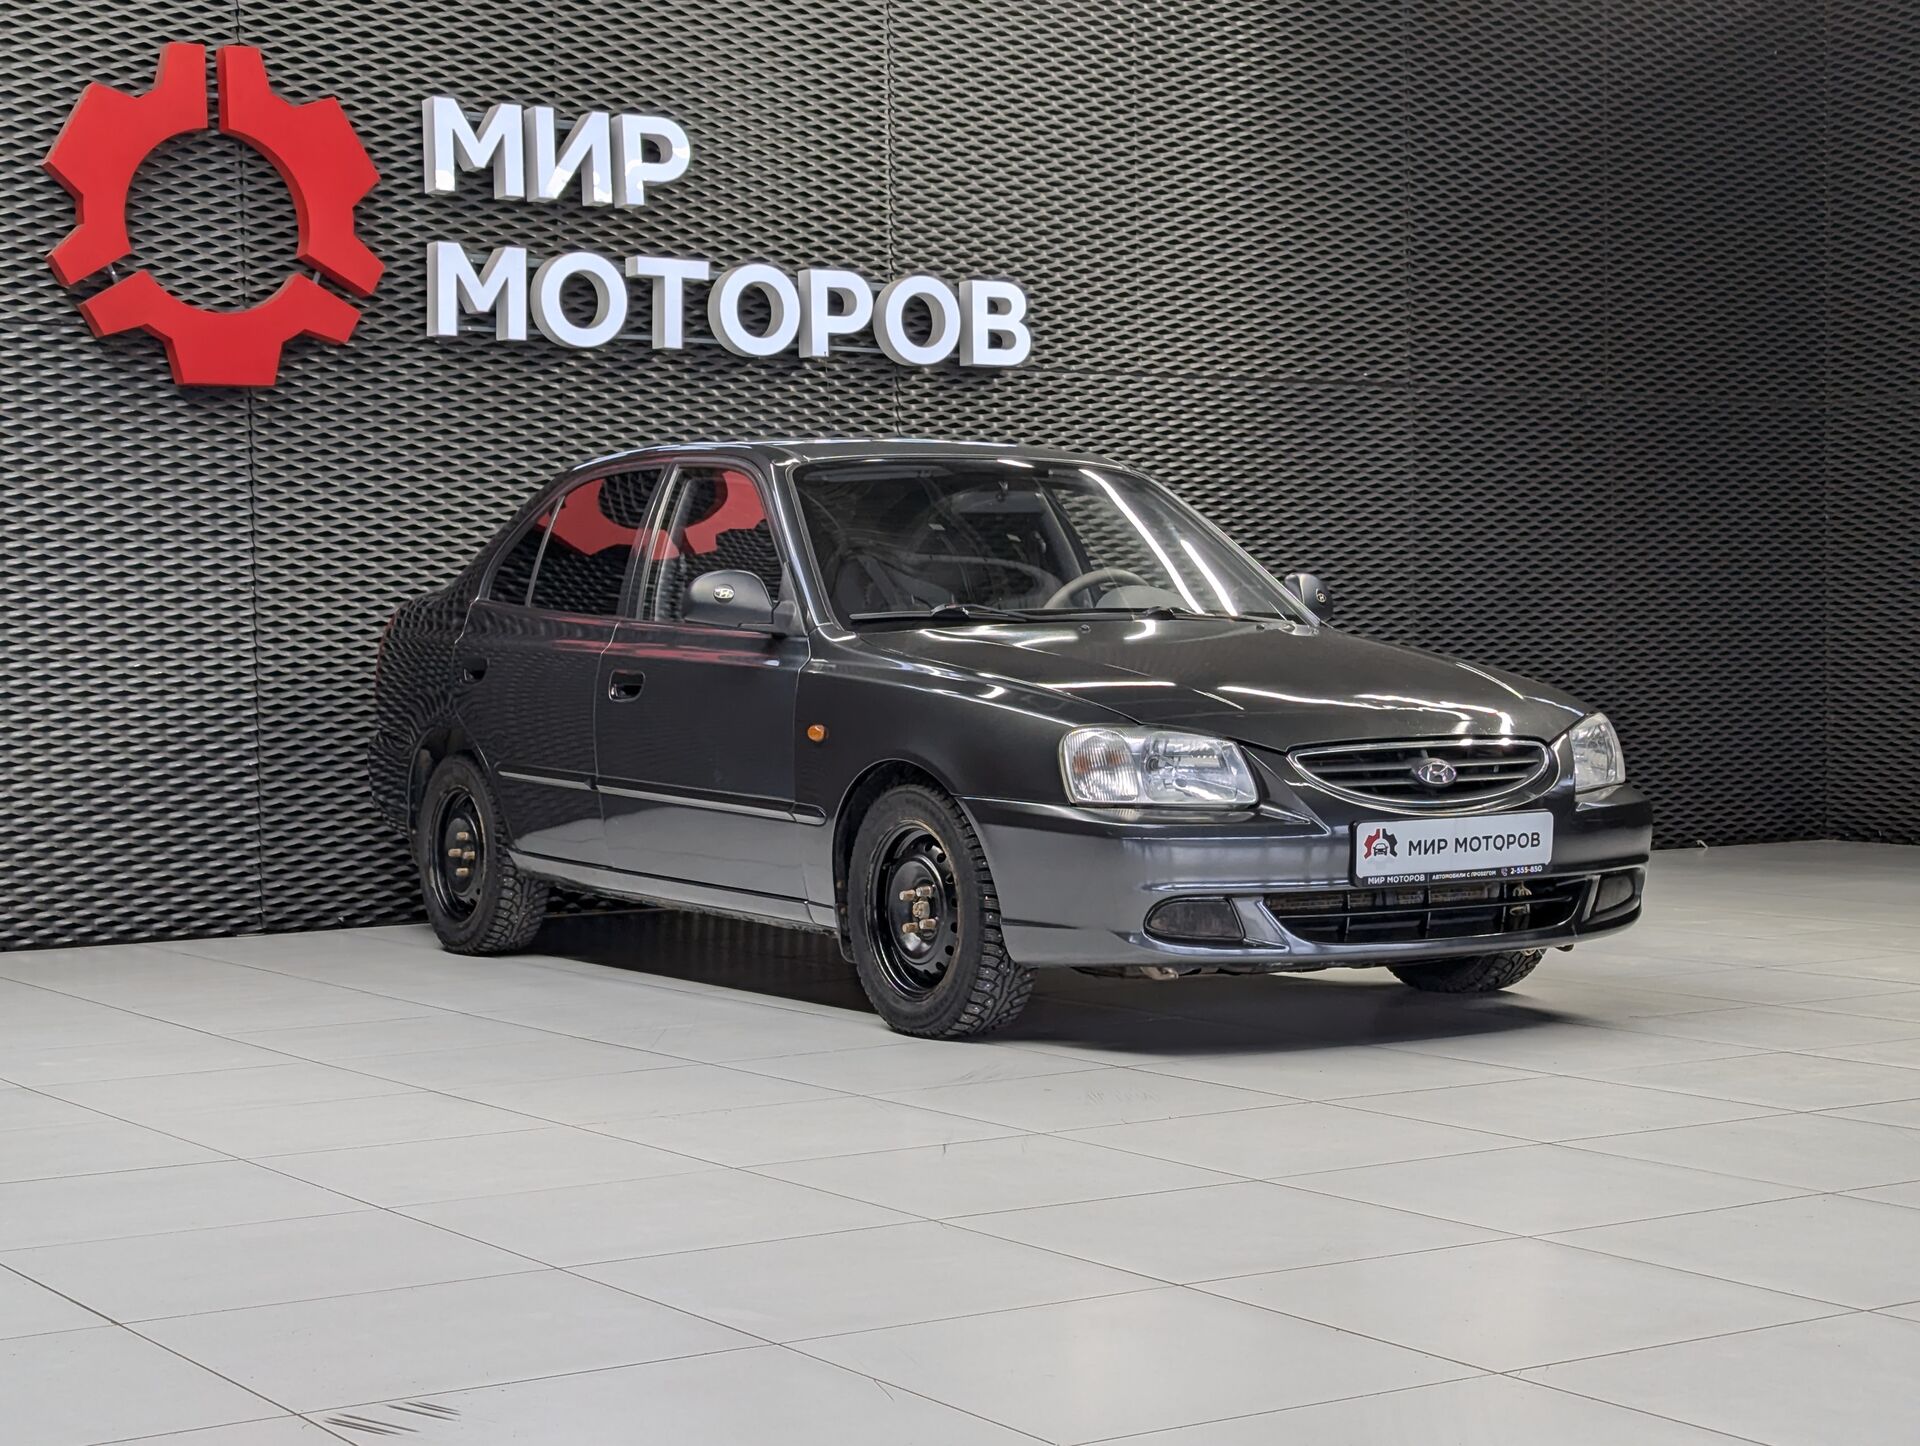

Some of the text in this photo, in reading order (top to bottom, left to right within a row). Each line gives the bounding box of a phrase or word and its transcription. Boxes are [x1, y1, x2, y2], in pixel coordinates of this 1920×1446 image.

[423, 96, 691, 209] МИР
[426, 240, 1032, 367] МОТОРОВ
[1408, 832, 1541, 856] МИР МОТОРОВ
[1368, 874, 1425, 884] МИР МОТОРОВ
